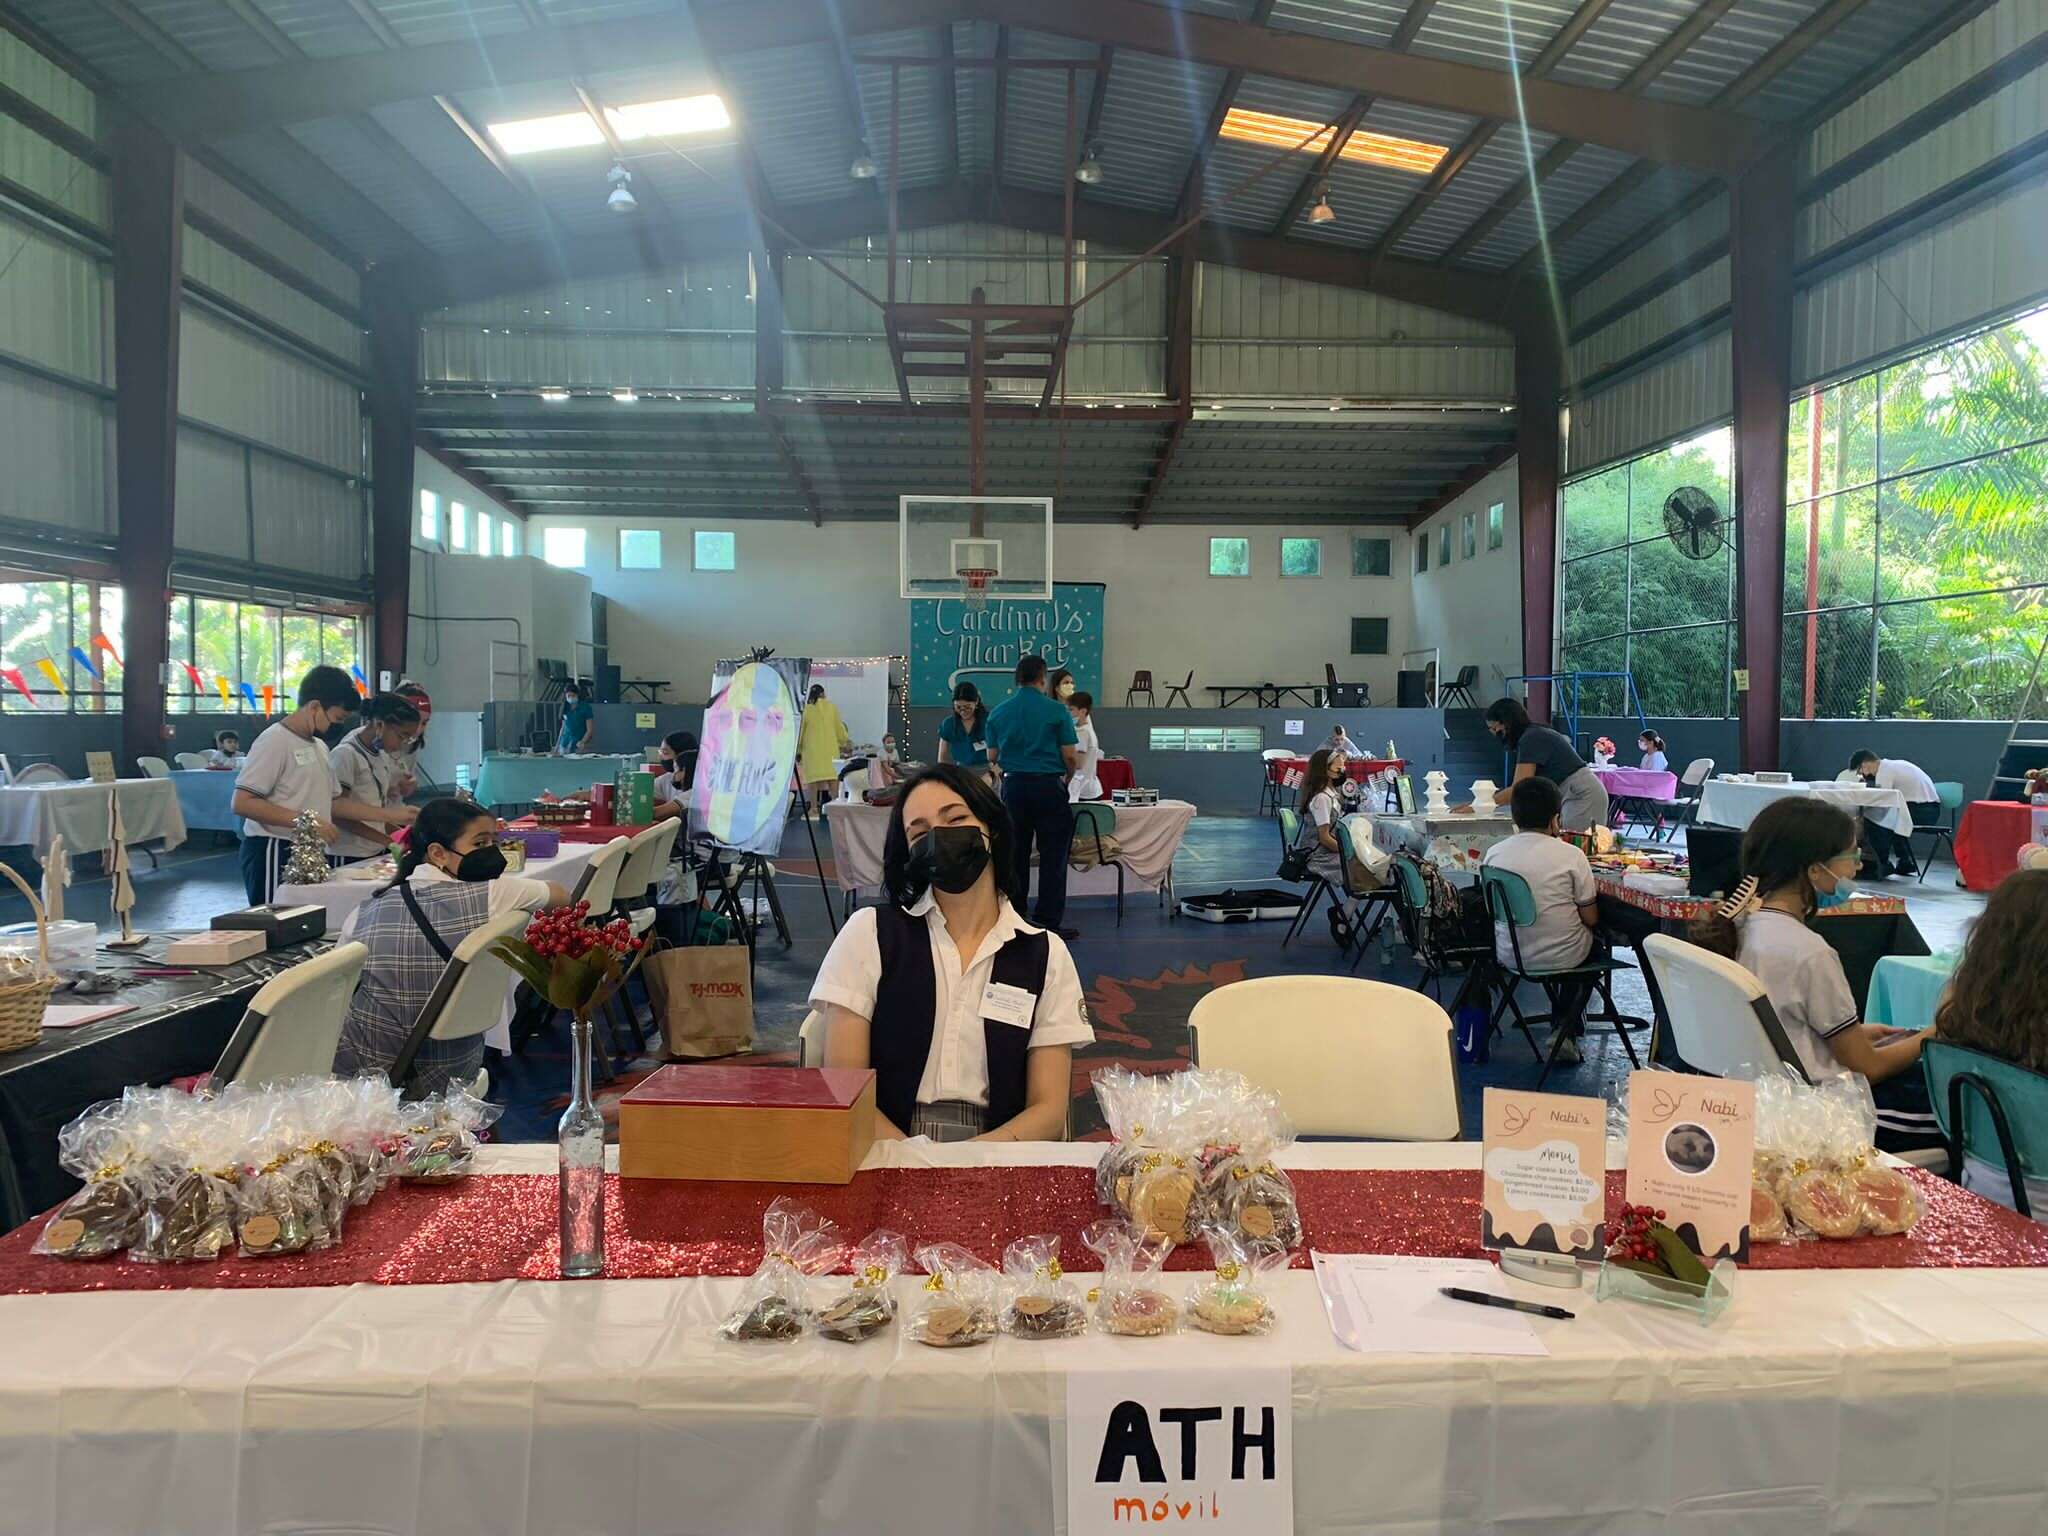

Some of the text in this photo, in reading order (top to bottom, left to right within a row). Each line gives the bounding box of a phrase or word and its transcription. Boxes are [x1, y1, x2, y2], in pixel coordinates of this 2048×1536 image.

[935, 599, 1085, 635] Cardinal's
[958, 634, 1070, 668] Market
[1550, 1110, 1591, 1126] Nabi's
[1701, 1099, 1738, 1117] Nabi
[1539, 1147, 1576, 1164] Menu
[1095, 1400, 1276, 1483] ATH
[1113, 1491, 1220, 1523] móvil
